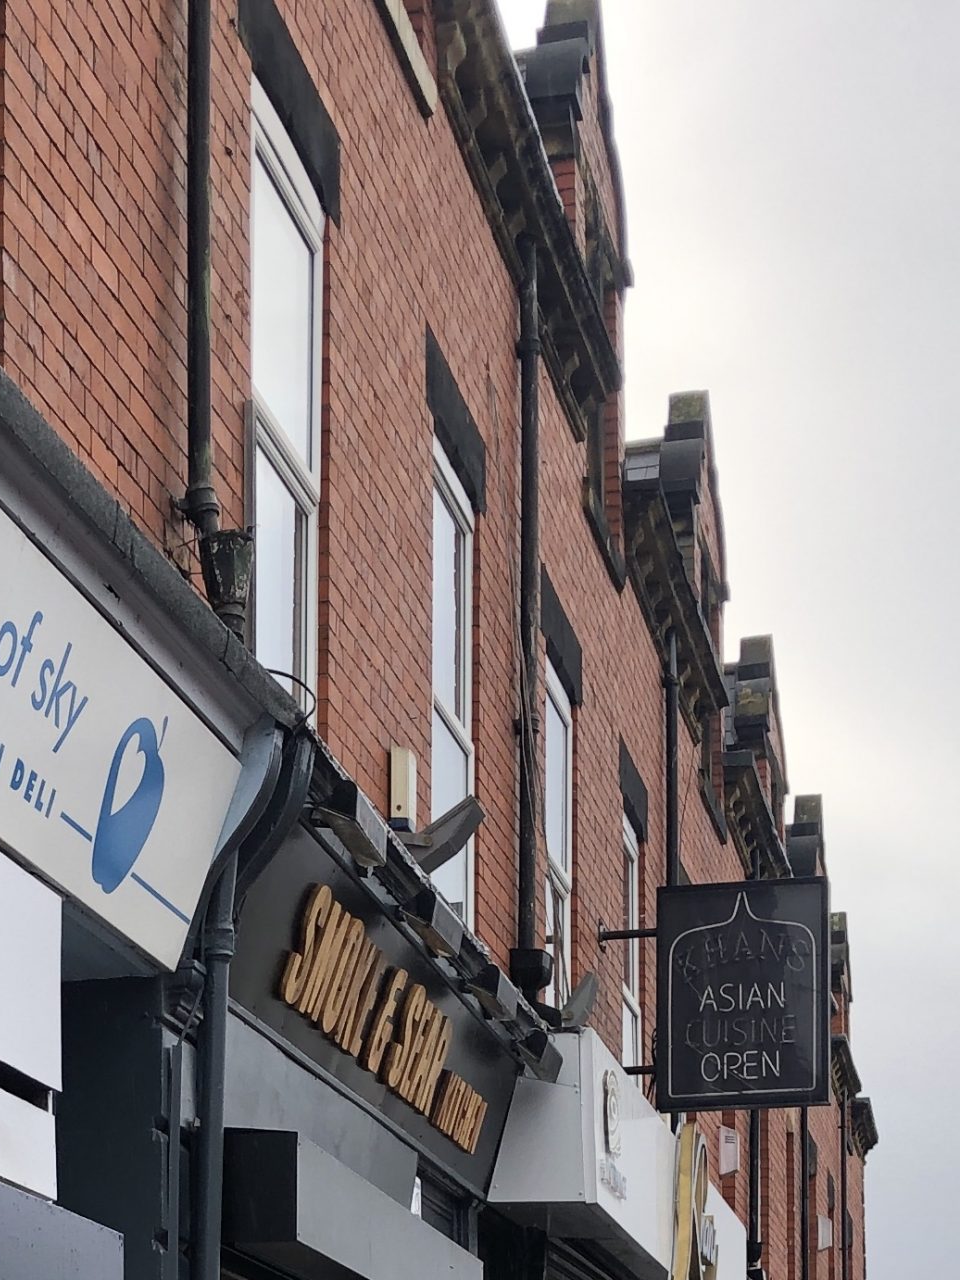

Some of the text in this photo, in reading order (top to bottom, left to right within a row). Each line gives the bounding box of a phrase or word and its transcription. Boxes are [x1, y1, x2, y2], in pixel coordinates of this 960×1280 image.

[30, 642, 89, 753] sky
[10, 757, 56, 819] DELI
[282, 884, 385, 1058] SMOKE
[388, 983, 453, 1118] SEAR
[699, 981, 787, 1012] ASIAN
[685, 1014, 798, 1048] CUISINE
[701, 1050, 781, 1082] OPEN
